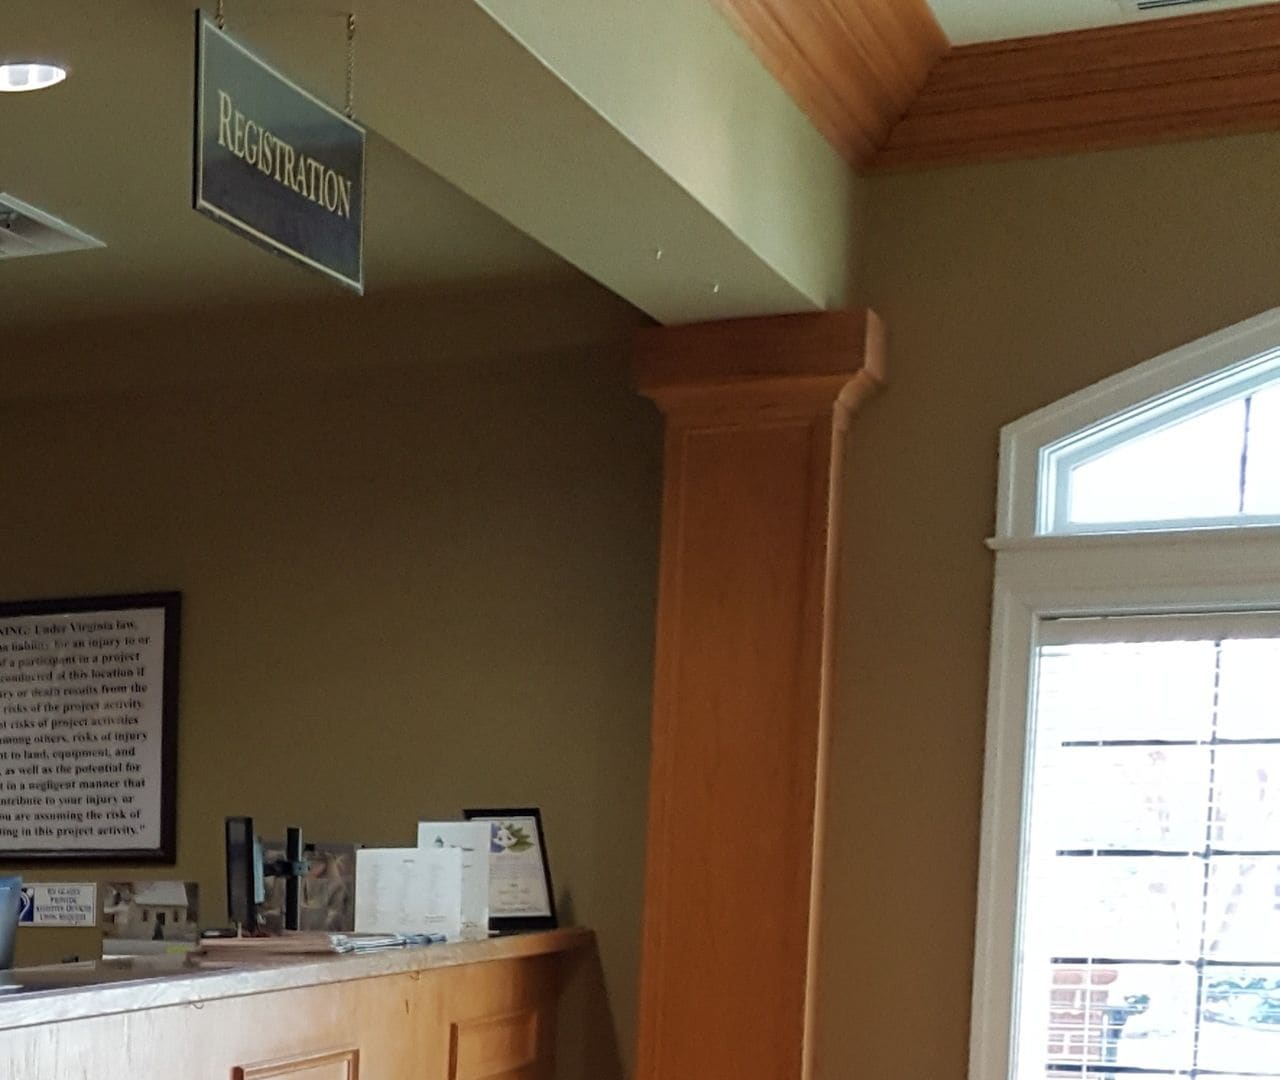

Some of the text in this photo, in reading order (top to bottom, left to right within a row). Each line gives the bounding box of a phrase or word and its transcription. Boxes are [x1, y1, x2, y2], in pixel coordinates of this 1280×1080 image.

[218, 89, 352, 219] REGISTRATION
[70, 622, 113, 633] Virginia
[88, 638, 120, 649] injury
[125, 636, 135, 645] to
[138, 636, 150, 645] or
[10, 660, 16, 668] a
[79, 655, 89, 664] in
[102, 651, 140, 665] project
[69, 668, 88, 679] this
[91, 667, 134, 678] location
[136, 666, 144, 677] if
[101, 684, 127, 694] from
[130, 682, 147, 693] the
[3, 703, 28, 714] risks
[30, 702, 41, 712] of
[43, 702, 59, 712] the
[63, 700, 100, 714] project
[10, 719, 35, 729] risks
[38, 717, 49, 727] of
[51, 716, 88, 730] project
[72, 732, 98, 742] risks
[100, 732, 111, 741] of
[114, 731, 148, 743] injury
[11, 751, 21, 760] to
[23, 749, 50, 760] land,
[114, 747, 136, 757] and
[4, 767, 15, 775] as
[18, 764, 39, 774] well
[41, 766, 53, 774] as
[56, 763, 72, 773] the
[74, 762, 122, 775] potential
[126, 761, 141, 772] for
[6, 782, 17, 790] in
[28, 780, 76, 792] negligent
[79, 780, 120, 789] manner
[123, 778, 146, 788] that
[45, 796, 55, 805] to
[58, 796, 82, 807] your
[86, 794, 118, 806] injury
[121, 795, 134, 804] or
[14, 812, 31, 820] are
[34, 810, 83, 822] assuming
[86, 809, 103, 820] the
[106, 808, 126, 819] risk
[130, 808, 141, 819] of
[21, 826, 31, 836] in
[35, 825, 53, 836] this
[56, 824, 93, 838] project
